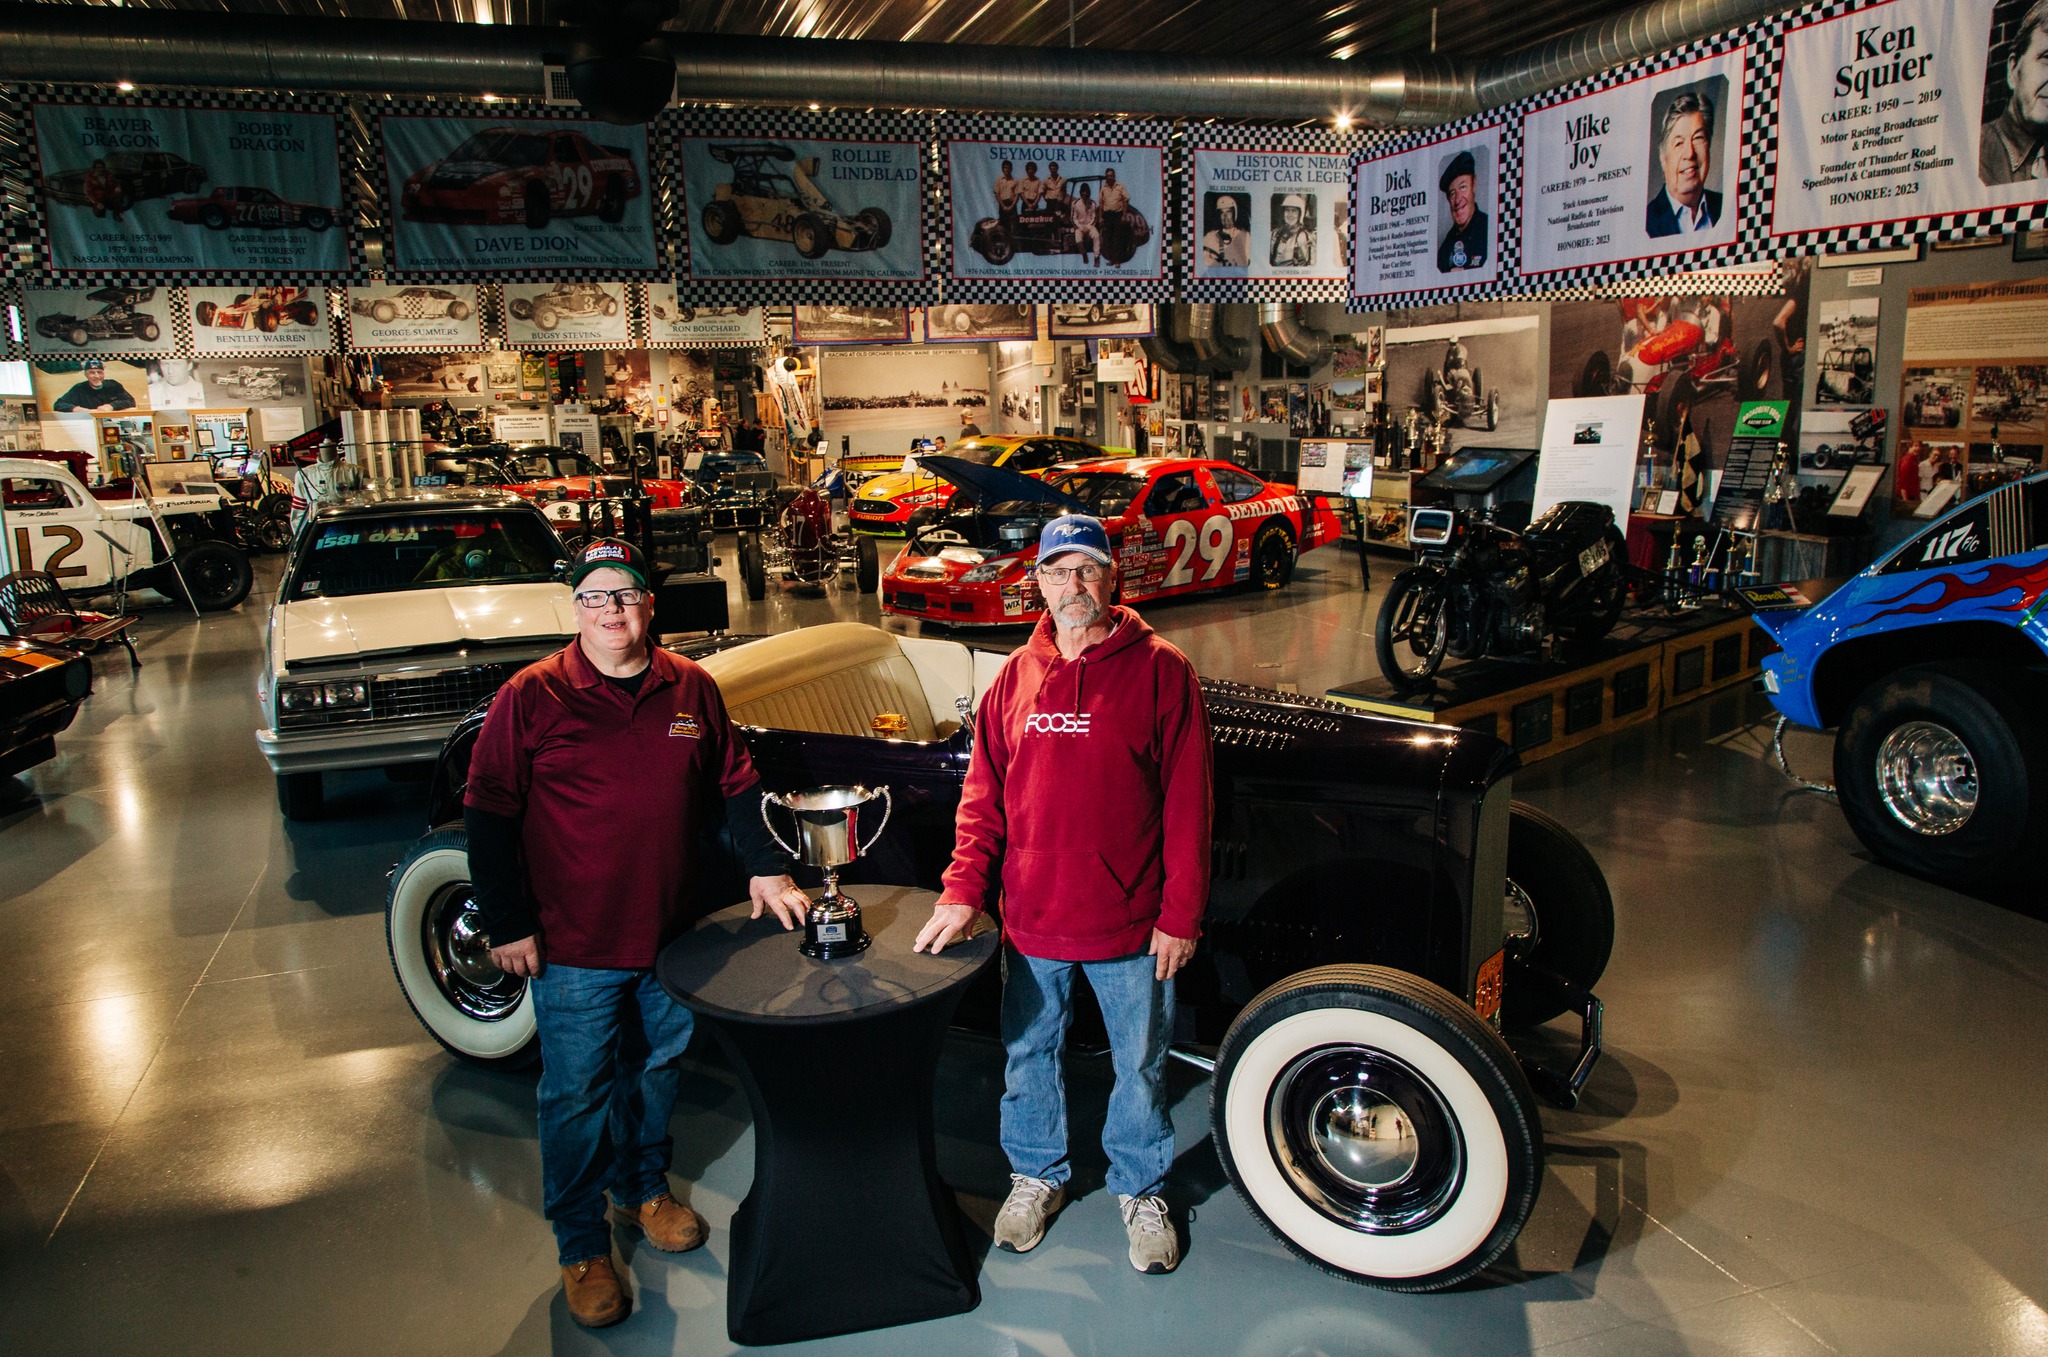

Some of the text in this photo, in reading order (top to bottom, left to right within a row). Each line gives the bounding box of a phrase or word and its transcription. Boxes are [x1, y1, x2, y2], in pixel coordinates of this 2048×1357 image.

[1854, 25, 1915, 63] Ken
[1834, 52, 1933, 99] Squier
[1821, 89, 1942, 125] CAREER: 1950 2019
[84, 117, 154, 132] BEAVER
[237, 122, 293, 137] BOBBY
[1565, 113, 1610, 145] Mike
[1820, 113, 1940, 145] Motor Racing Broadcaster
[81, 132, 160, 148] DRAGON
[229, 137, 305, 152] DRAGON
[1852, 133, 1904, 151] & Producer
[832, 148, 892, 163] ROLLIE
[989, 147, 1125, 163] SEYMOUR FAMILY
[1236, 155, 1349, 169] HISTORIC NEMA
[1570, 142, 1602, 170] Joy
[1820, 146, 1937, 175] Founder of Thunder Road
[832, 167, 918, 182] LINDBLAD
[1212, 168, 1302, 182] MIDGET CAR
[1385, 168, 1412, 193] Dick
[1541, 166, 1632, 195] CAREER: 1970 PRESENT
[1802, 156, 1954, 190] Speedbowl & Catamount Stadium
[1577, 194, 1609, 207] Announcer
[1829, 182, 1919, 206] HONOREE: 2023
[1370, 190, 1427, 217] Berggren
[1406, 215, 1430, 227] PRESENT
[1547, 213, 1570, 226] National
[1571, 211, 1586, 222] Radio
[1595, 204, 1624, 216] Television
[1567, 220, 1600, 232] Broadcaster
[89, 234, 128, 242] CAREER:
[228, 235, 266, 243] CAREER:
[474, 237, 579, 252] DAVE DION
[1557, 237, 1594, 252] HONOREE:
[248, 247, 294, 255] VICTORIES
[73, 255, 194, 264] NASCAR NORTH CHAMPION
[258, 256, 293, 265] TRACKS
[492, 257, 513, 265] WITH
[523, 256, 570, 265] VOLUNTEER
[713, 268, 732, 276] CARS
[733, 268, 751, 276] WON
[752, 268, 772, 276] OVER
[979, 268, 1012, 276] NATIONAL
[1035, 268, 1060, 276] CROWN
[1062, 268, 1098, 276] CHAMPIONS
[216, 334, 306, 343] BENTLEY WARREN
[371, 328, 459, 337] GEORGE SUMMERS
[562, 331, 601, 339] STEVENS
[1223, 495, 1311, 521] BERLIN CITY
[1921, 522, 1974, 563] 117
[14, 525, 87, 578] 12
[1160, 514, 1235, 590] 29
[1005, 600, 1020, 610] WIX
[1025, 713, 1091, 733] FOOSE
